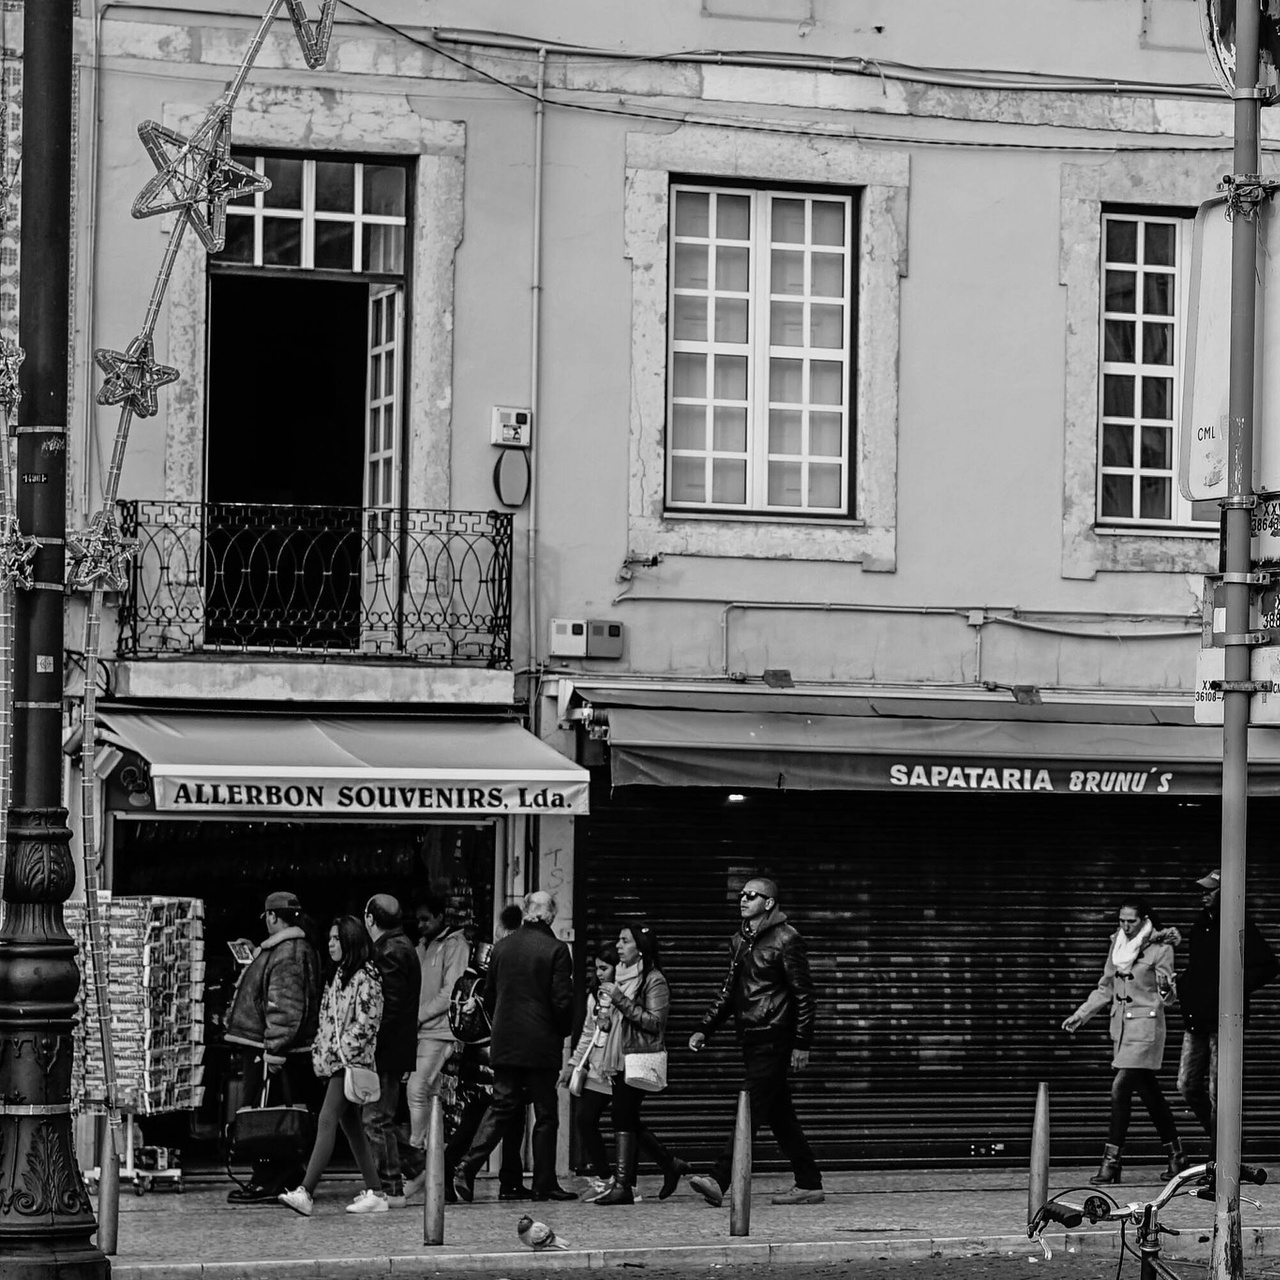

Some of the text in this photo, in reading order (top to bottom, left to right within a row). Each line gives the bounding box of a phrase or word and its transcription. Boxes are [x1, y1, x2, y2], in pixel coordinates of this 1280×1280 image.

[1197, 425, 1216, 442] CML
[889, 764, 1054, 791] SAPATARIA
[173, 783, 572, 810] ALLERBON SOUVENIRS, Lda.
